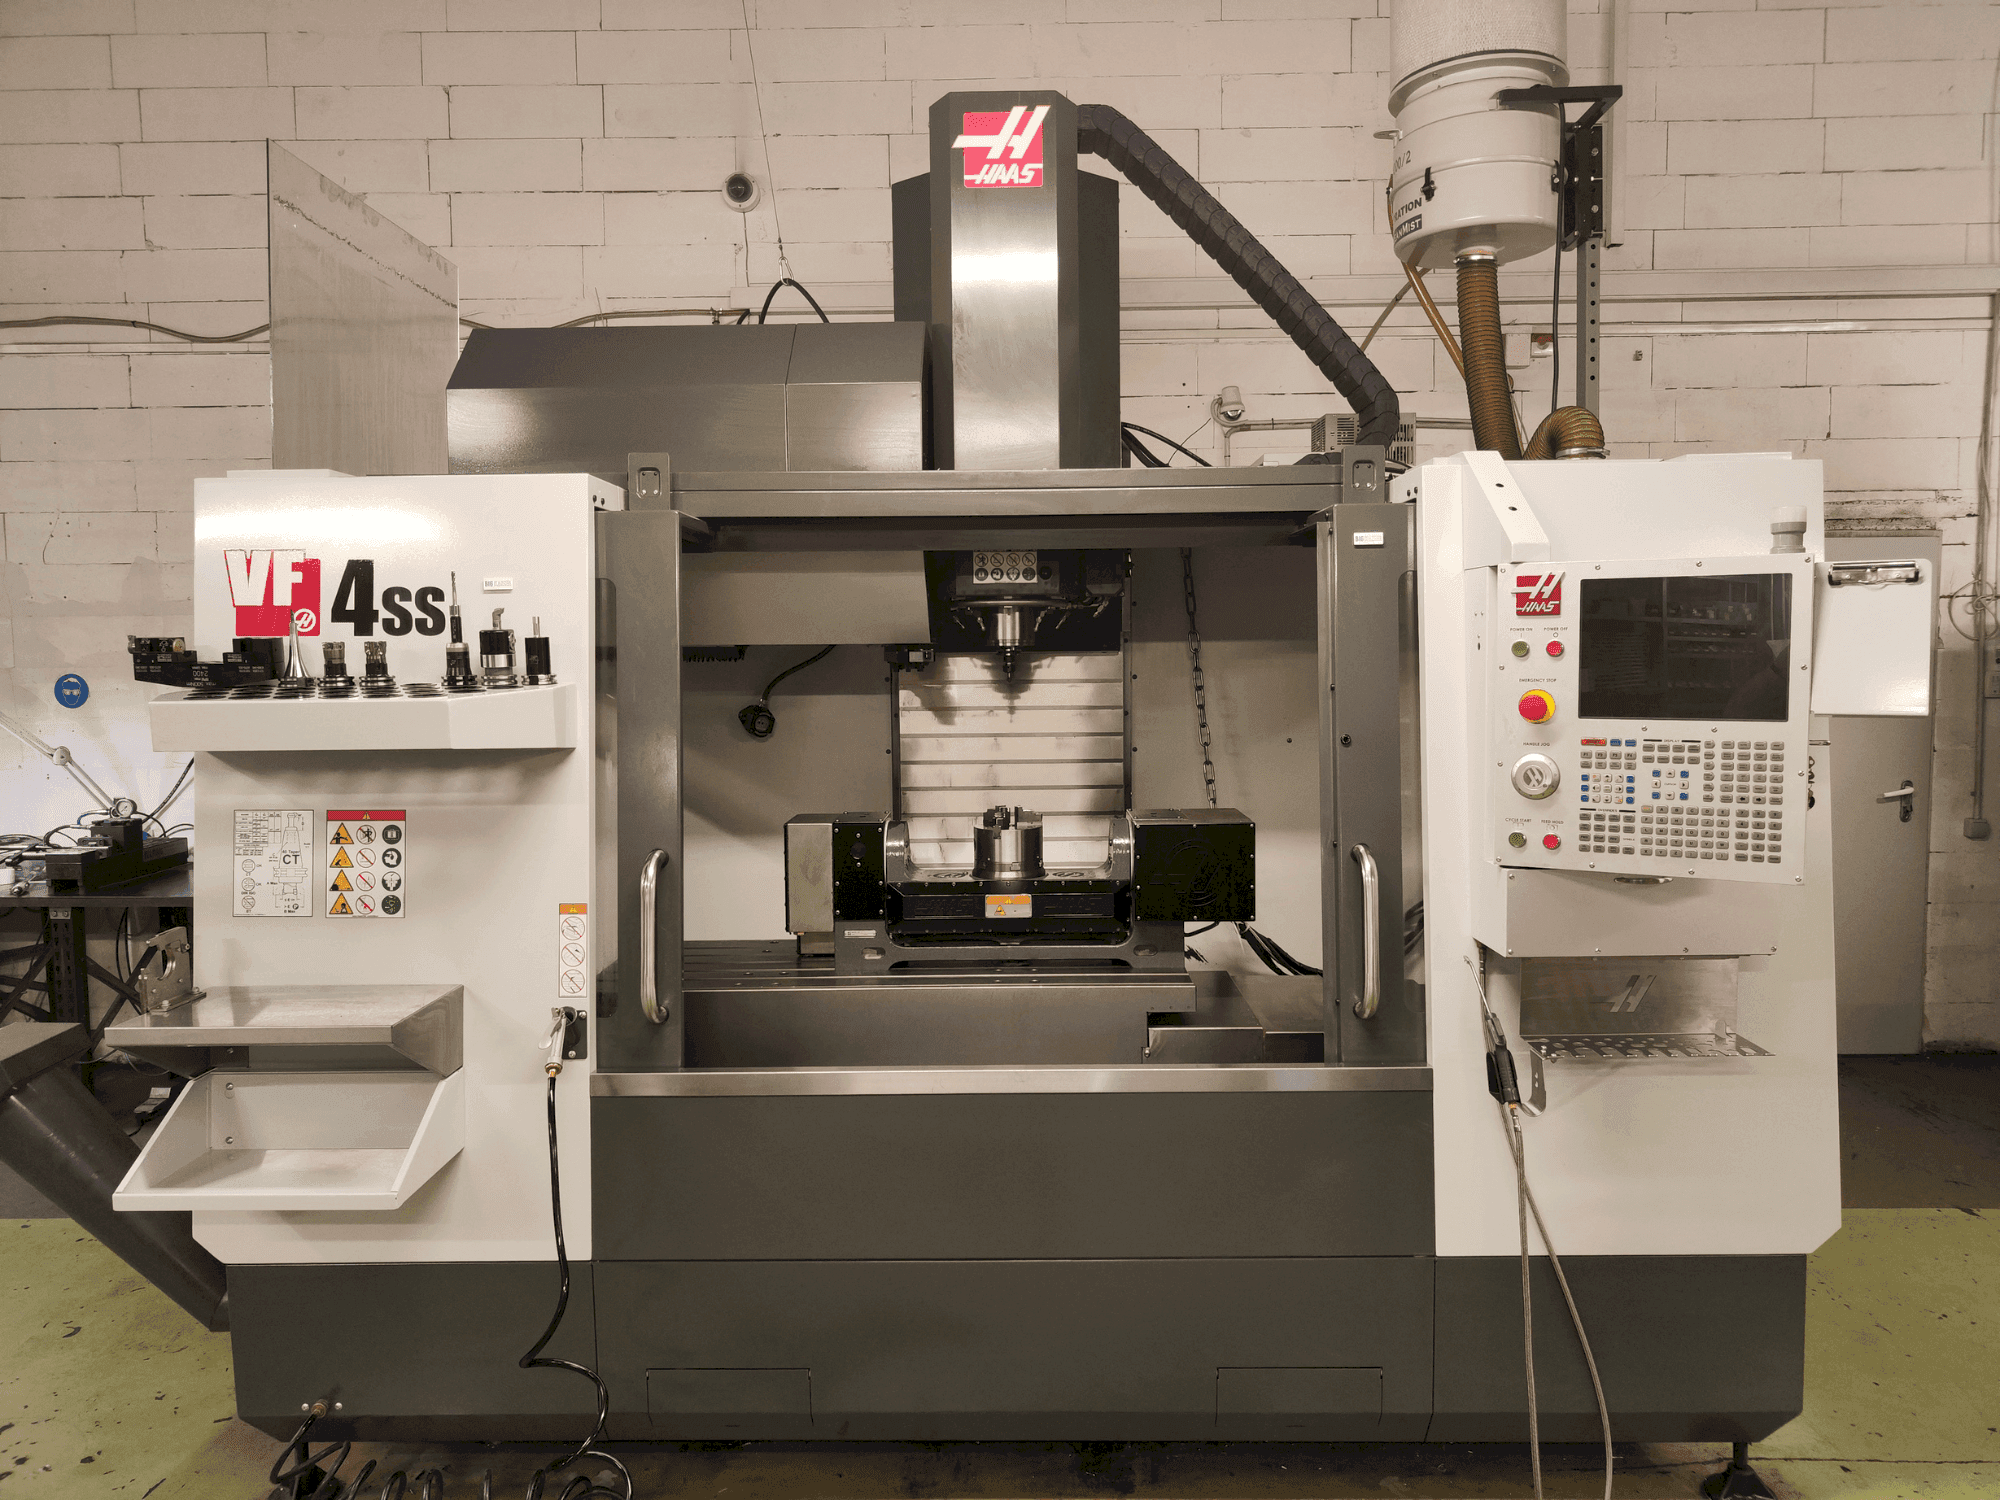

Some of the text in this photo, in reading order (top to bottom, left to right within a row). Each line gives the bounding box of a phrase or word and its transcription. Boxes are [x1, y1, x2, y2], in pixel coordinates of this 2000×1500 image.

[964, 163, 1043, 184] HAAS
[223, 549, 306, 607] VF
[1516, 601, 1560, 612] HAAS
[283, 854, 300, 864] CT
